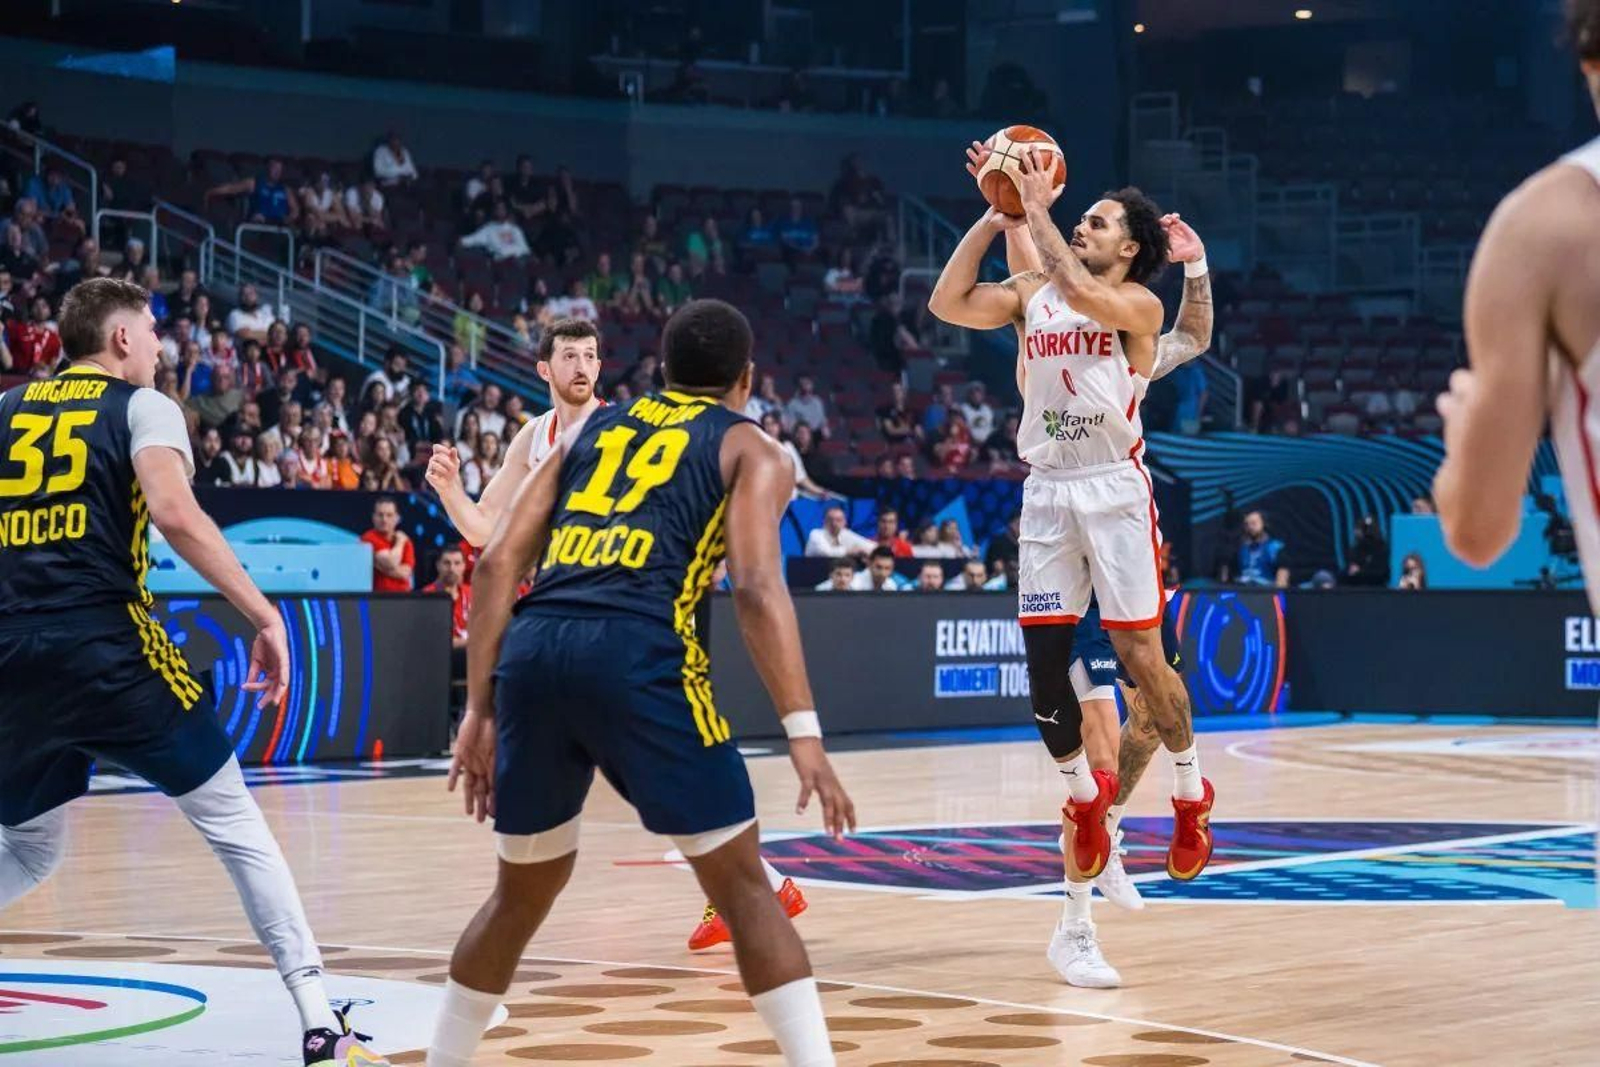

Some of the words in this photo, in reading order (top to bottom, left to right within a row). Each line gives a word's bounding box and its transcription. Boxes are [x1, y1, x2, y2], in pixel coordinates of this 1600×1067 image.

[1026, 325, 1112, 360] TÜRKİYE
[23, 379, 108, 403] BIRGANDER
[0, 410, 98, 497] 35
[564, 424, 690, 517] 19
[0, 503, 87, 548] NOCCO
[542, 523, 655, 571] NOCCO
